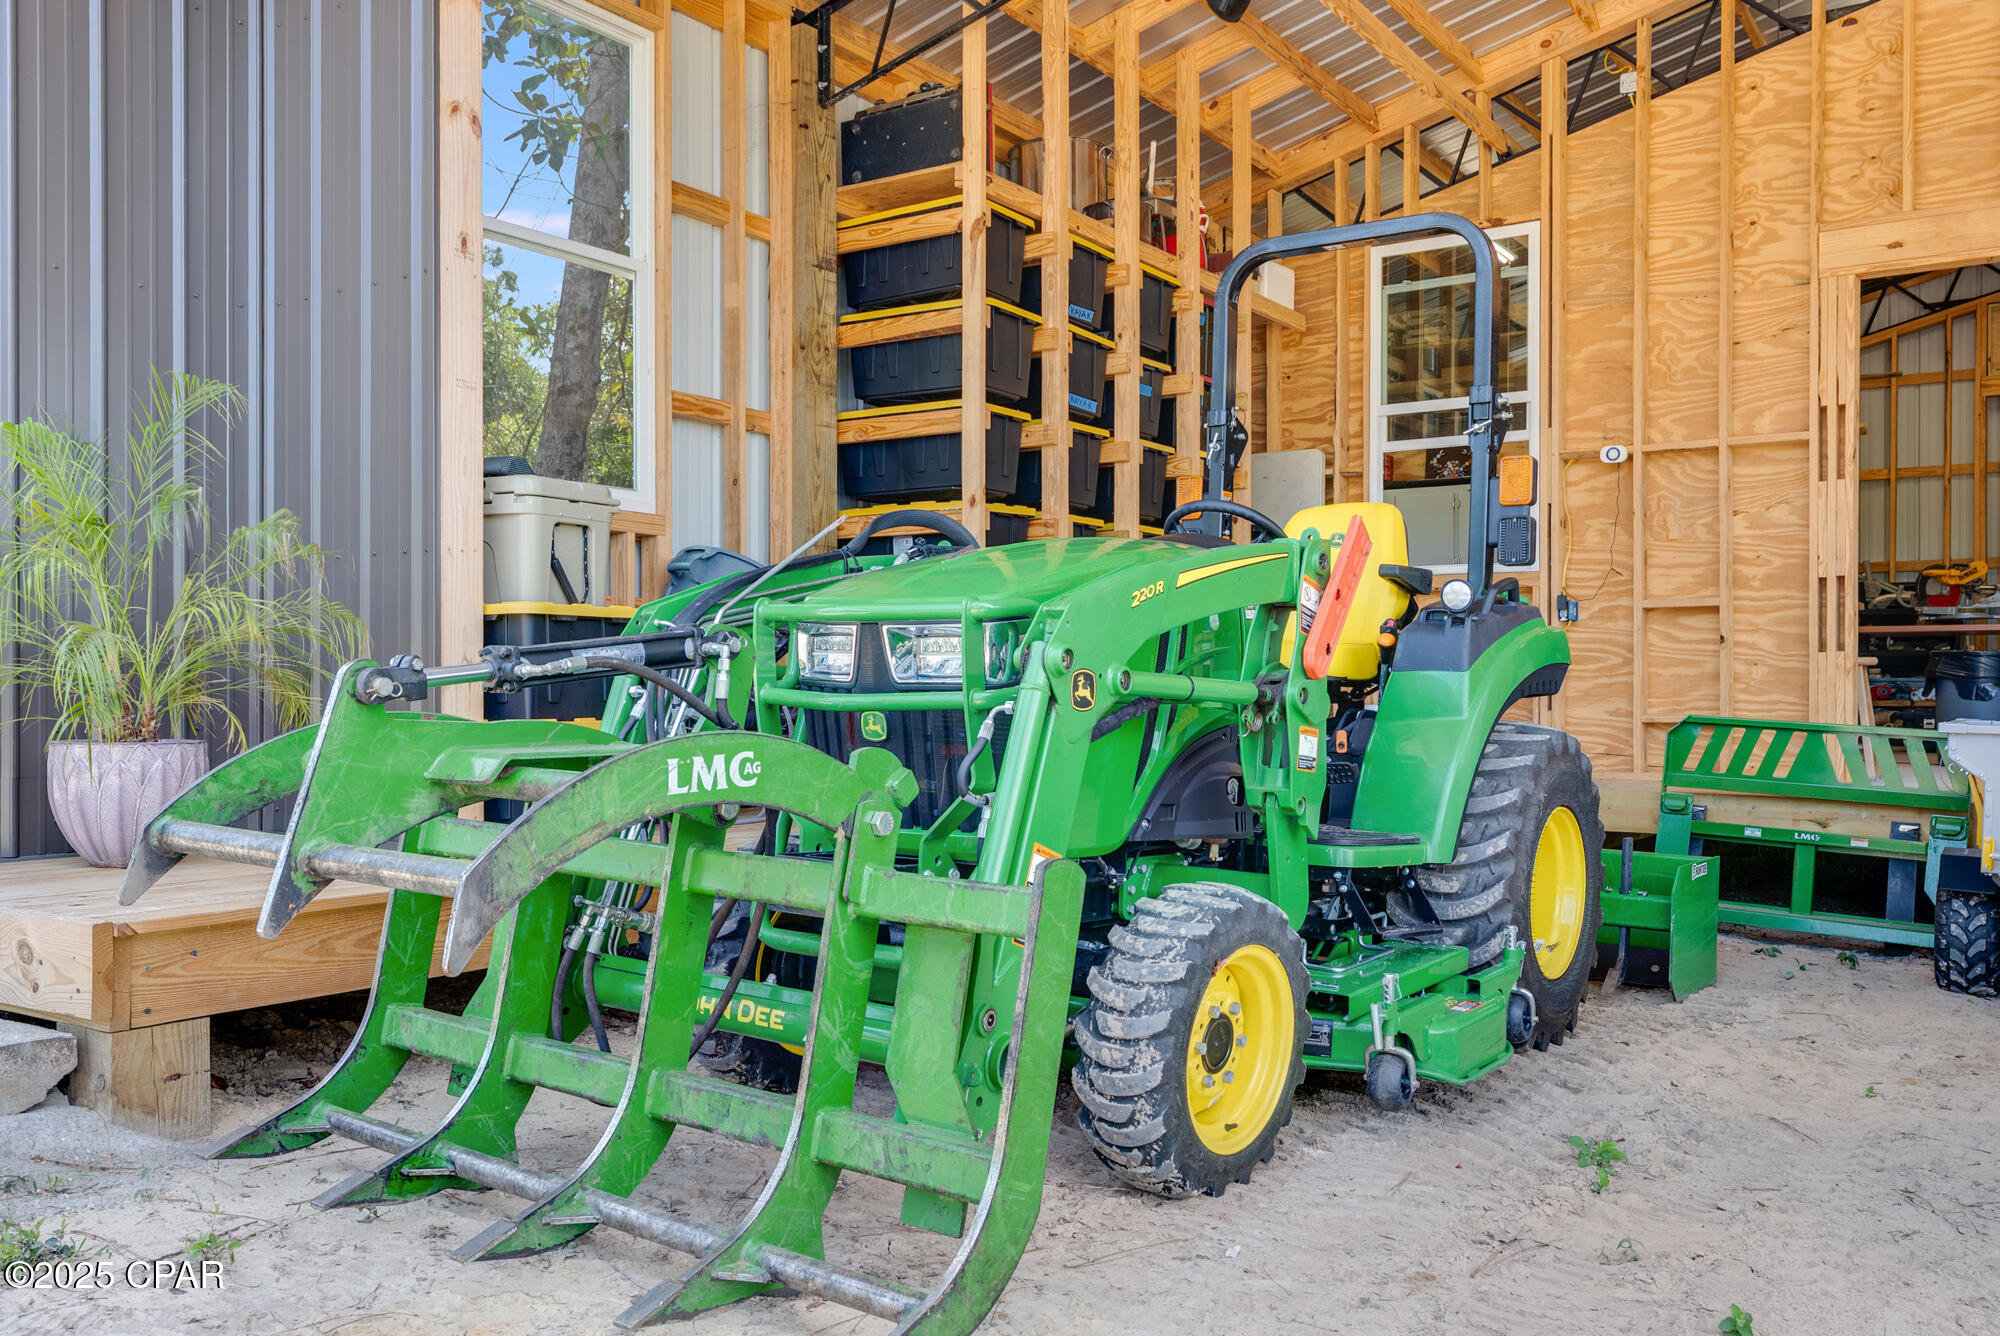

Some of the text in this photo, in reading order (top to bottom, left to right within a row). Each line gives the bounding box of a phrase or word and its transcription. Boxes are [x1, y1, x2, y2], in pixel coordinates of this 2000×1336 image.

[1070, 305, 1092, 321] KAYAK
[1070, 395, 1093, 410] KAYAK
[666, 751, 762, 796] LMC AG
